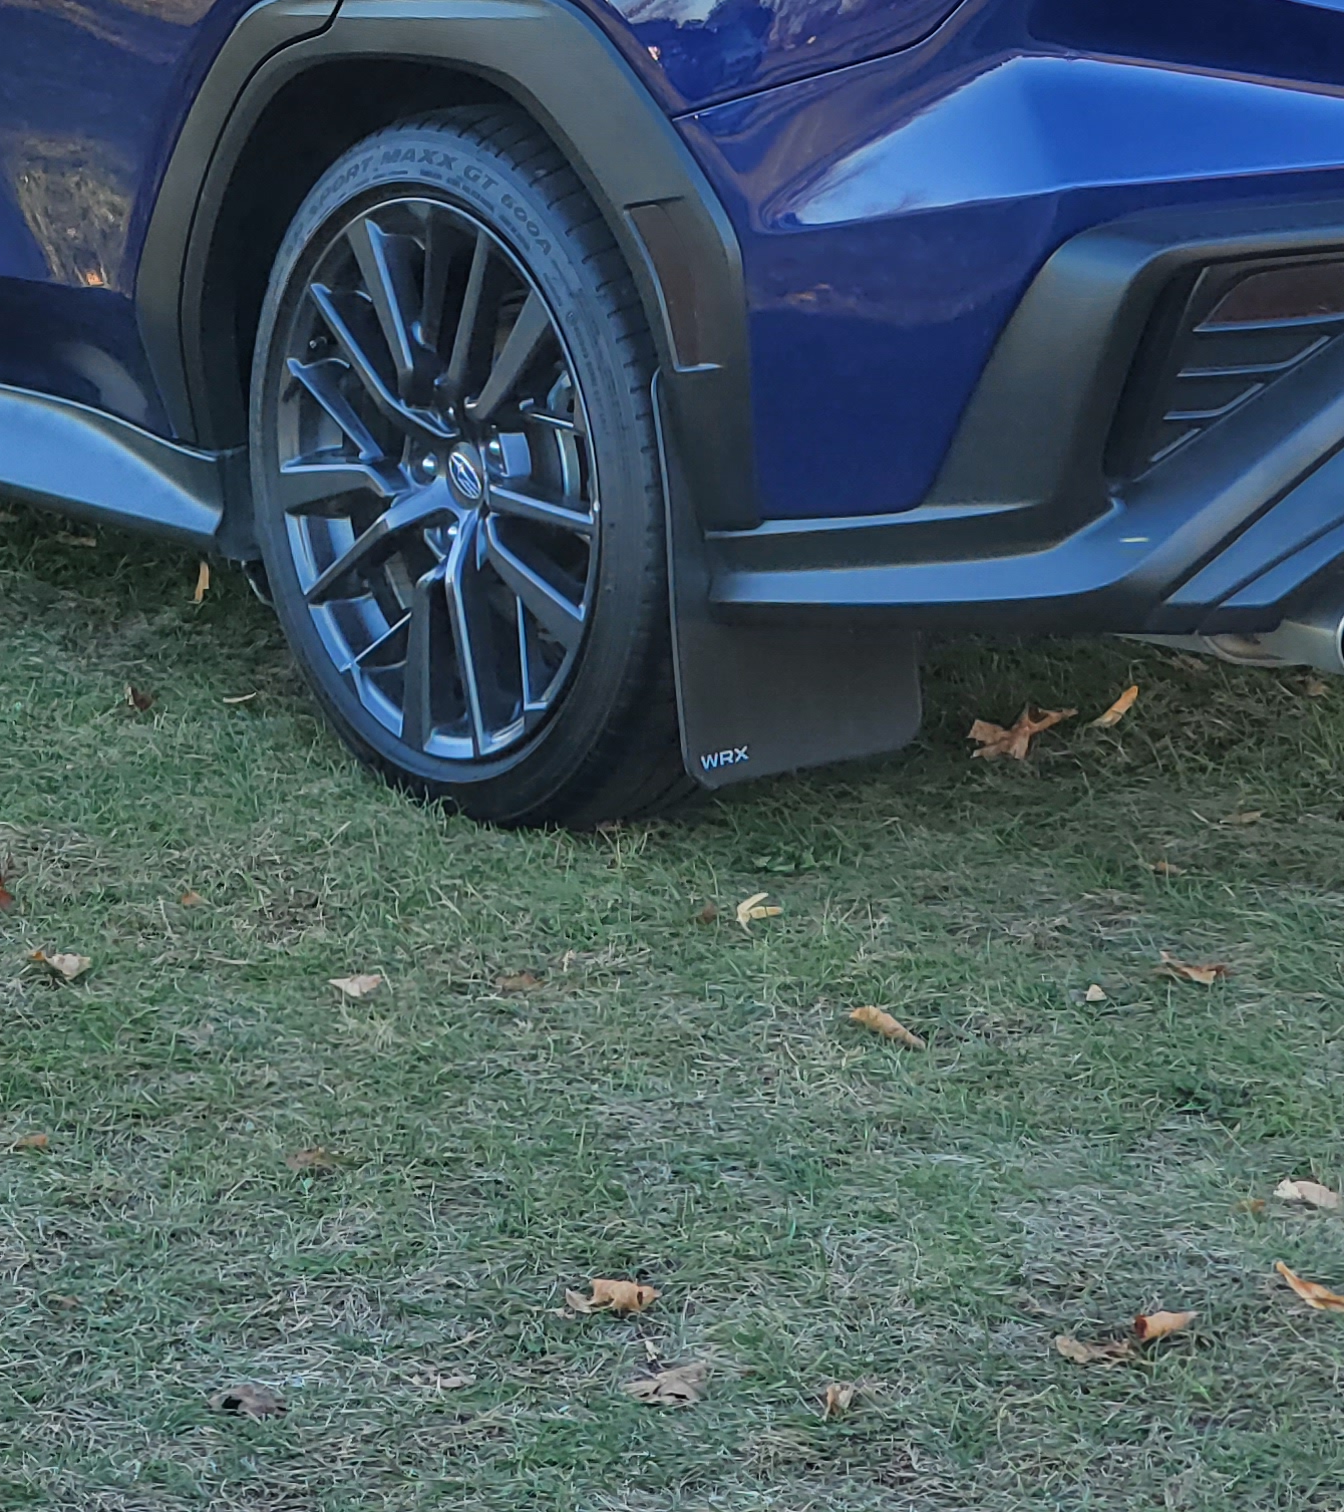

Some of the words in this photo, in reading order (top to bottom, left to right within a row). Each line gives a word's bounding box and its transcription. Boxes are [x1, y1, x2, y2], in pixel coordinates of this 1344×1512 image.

[380, 148, 458, 171] MAXX
[463, 165, 499, 191] GT
[500, 193, 552, 256] 600A
[700, 745, 750, 771] WRX
